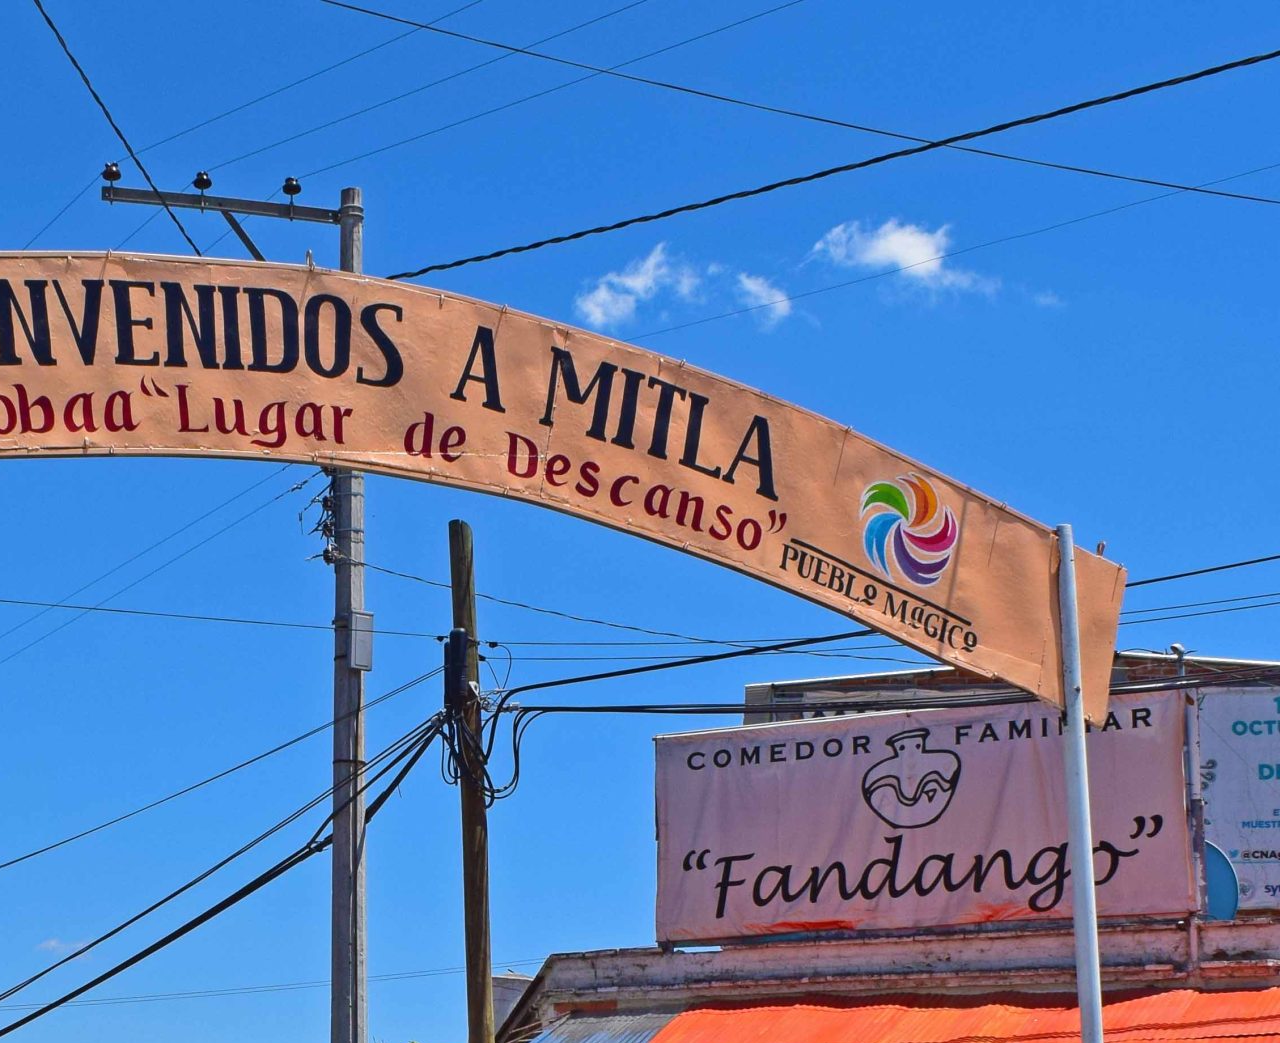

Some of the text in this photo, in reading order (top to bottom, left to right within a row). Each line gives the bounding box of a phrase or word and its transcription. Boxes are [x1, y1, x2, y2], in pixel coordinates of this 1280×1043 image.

[449, 326, 507, 414] A
[539, 345, 780, 502] MITLA
[403, 411, 467, 463] de
[1231, 720, 1280, 736] OCT
[687, 734, 872, 772] COMEDOR
[1242, 820, 1280, 829] MUEST
